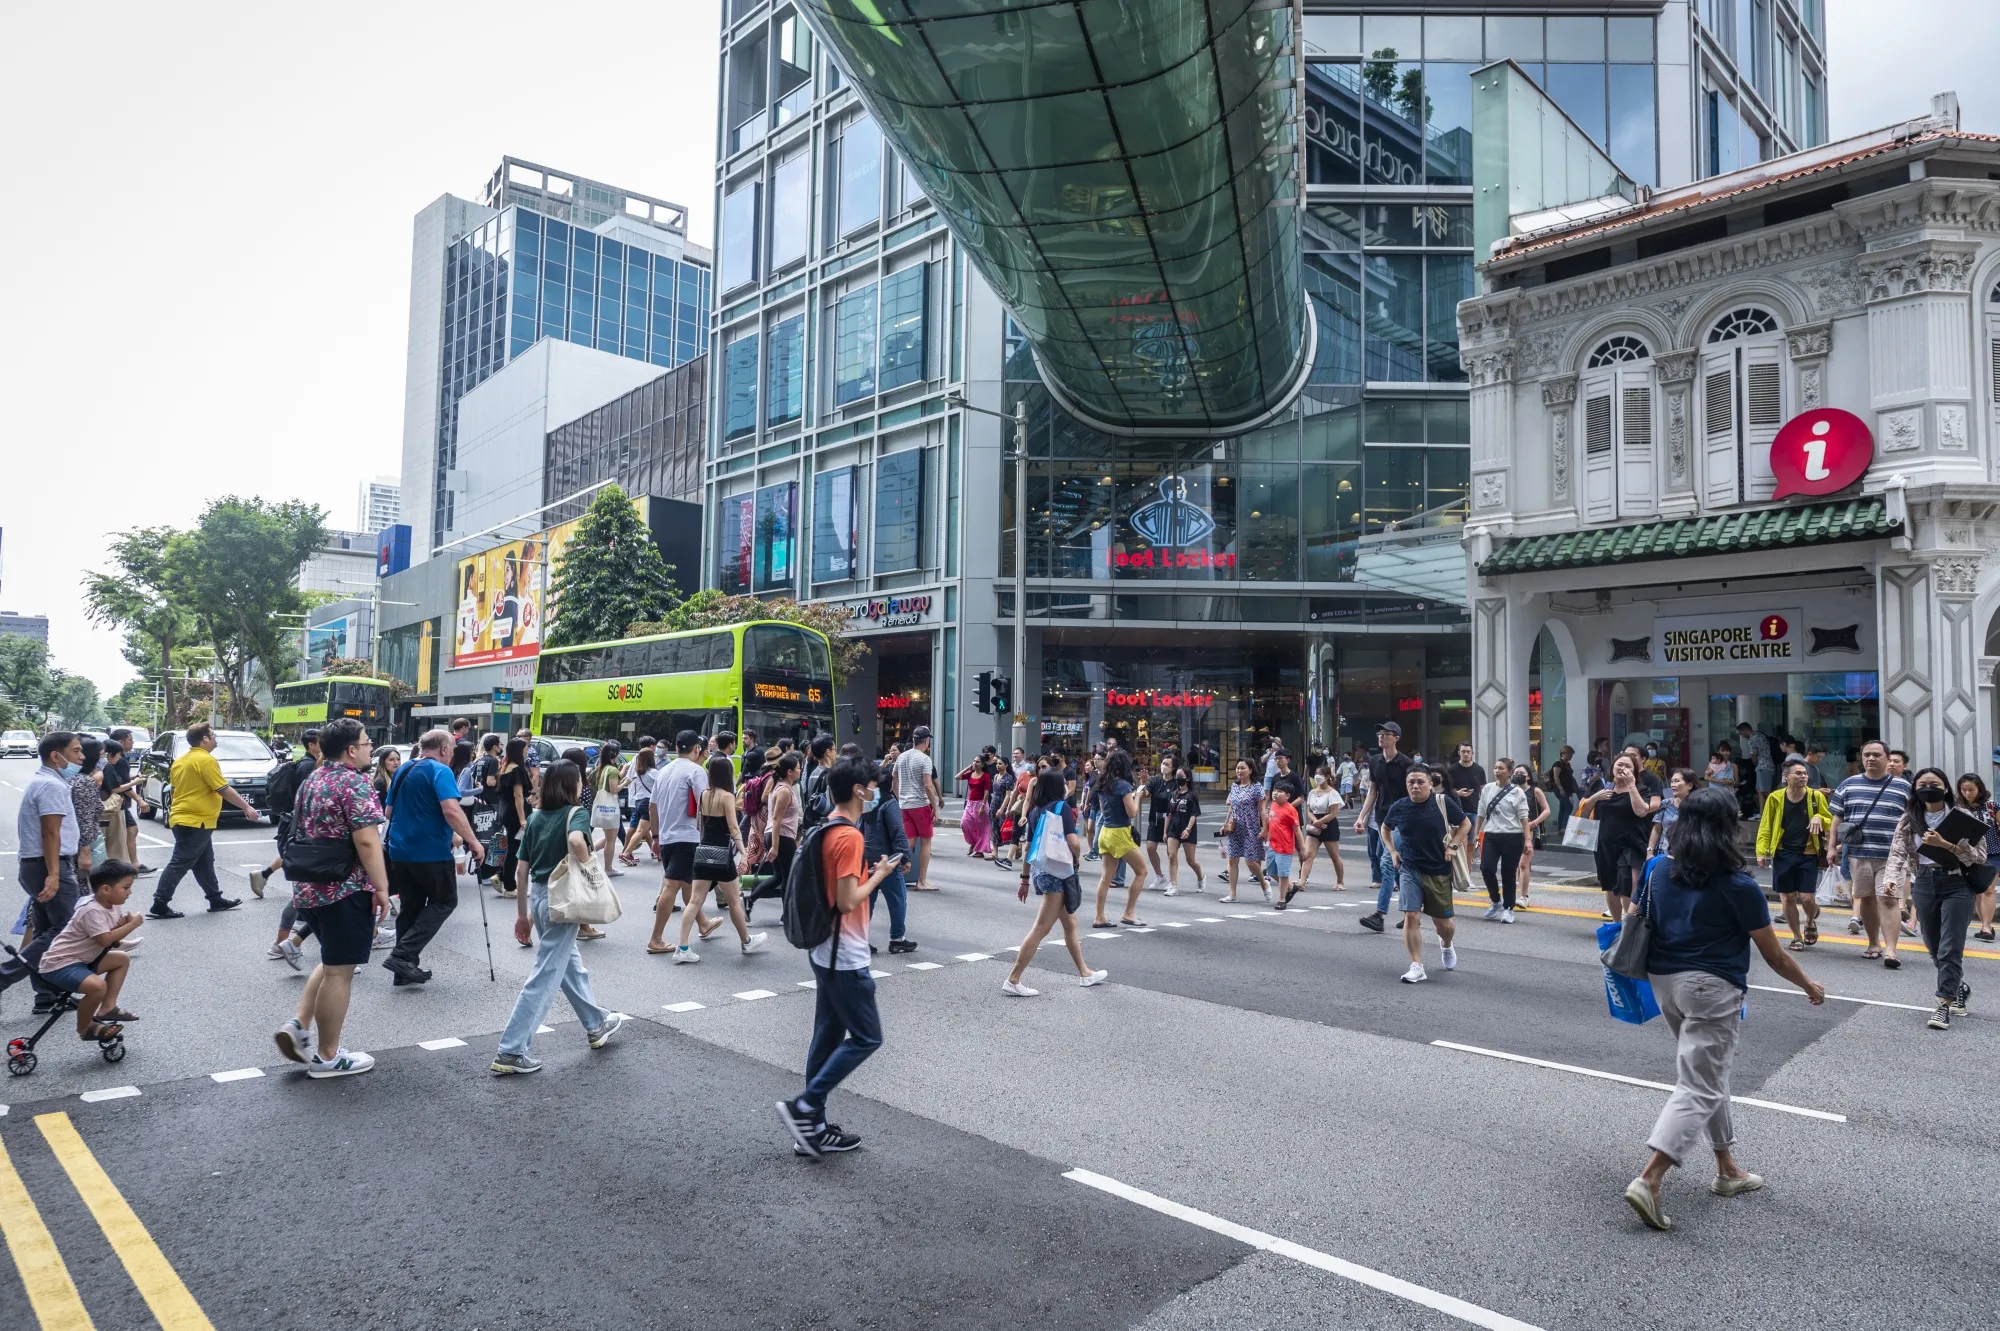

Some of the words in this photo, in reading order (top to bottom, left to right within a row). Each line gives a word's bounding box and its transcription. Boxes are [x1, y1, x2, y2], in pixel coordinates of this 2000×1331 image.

[1162, 548, 1236, 568] Locker
[1664, 627, 1752, 646] SINGAPORE
[1664, 645, 1725, 662] VISITOR
[1730, 642, 1791, 659] CENTRE
[505, 662, 537, 677] MIDPOIN
[761, 690, 789, 700] TAMPINES
[790, 692, 800, 701] INT
[808, 688, 821, 702] 65
[1107, 689, 1147, 707] Foot
[1152, 690, 1213, 707] Locker
